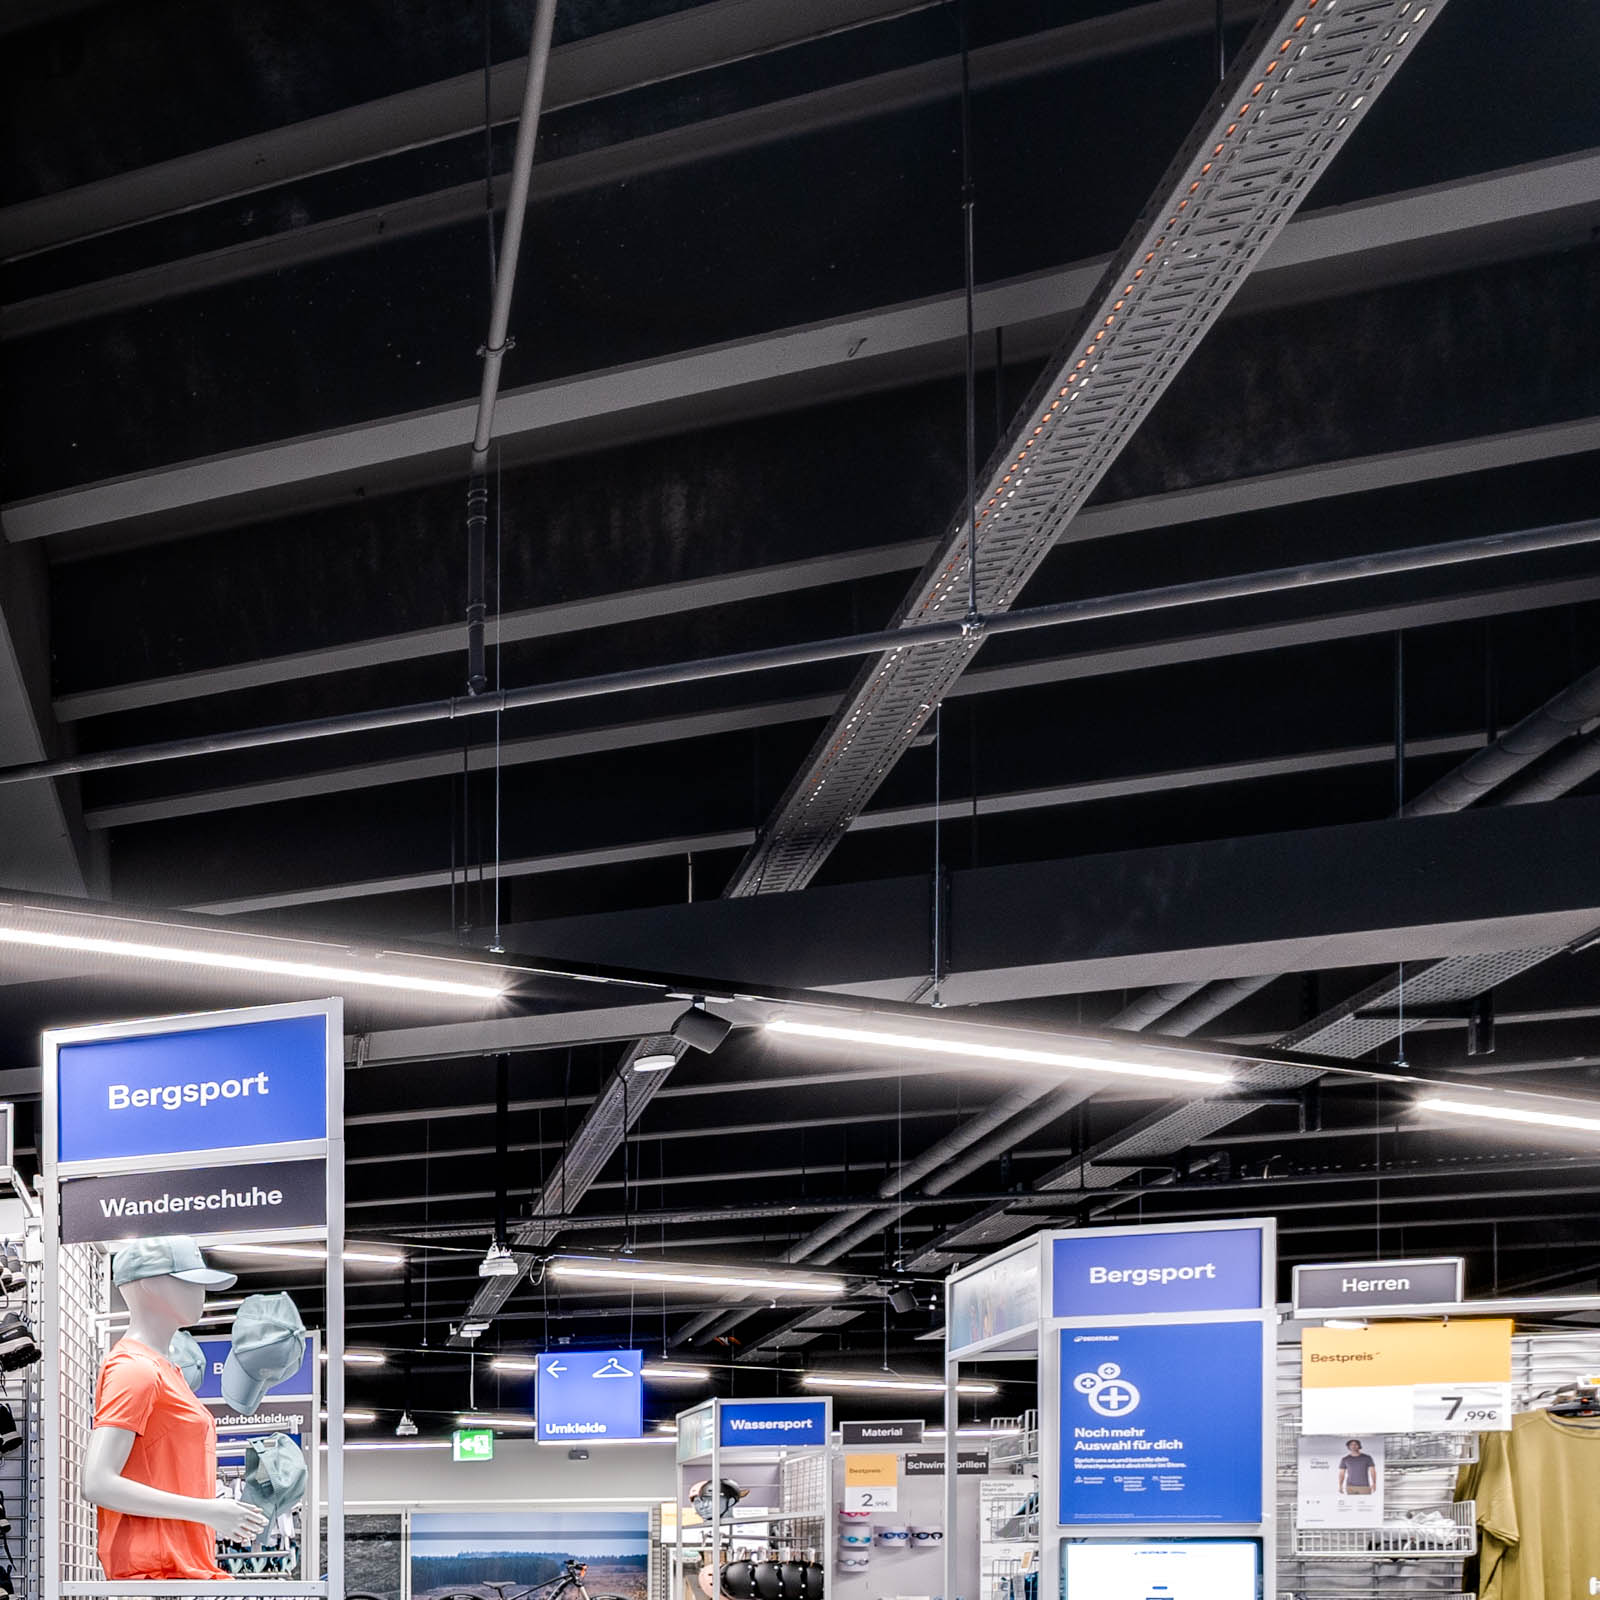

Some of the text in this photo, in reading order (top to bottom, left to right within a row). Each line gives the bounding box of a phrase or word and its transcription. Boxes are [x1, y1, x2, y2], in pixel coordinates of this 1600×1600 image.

[107, 1072, 270, 1111] Bergsport
[99, 1187, 283, 1218] Wanderschuhe
[1089, 1262, 1216, 1286] Bergsport
[1341, 1277, 1410, 1294] Herren
[1310, 1352, 1374, 1364] Bestpreis
[545, 1422, 607, 1434] Umkleide
[730, 1418, 813, 1432] Wassersport
[862, 1428, 903, 1437] Material
[1074, 1427, 1145, 1438] Noch mehr
[1074, 1439, 1183, 1451] Auswahl für dich
